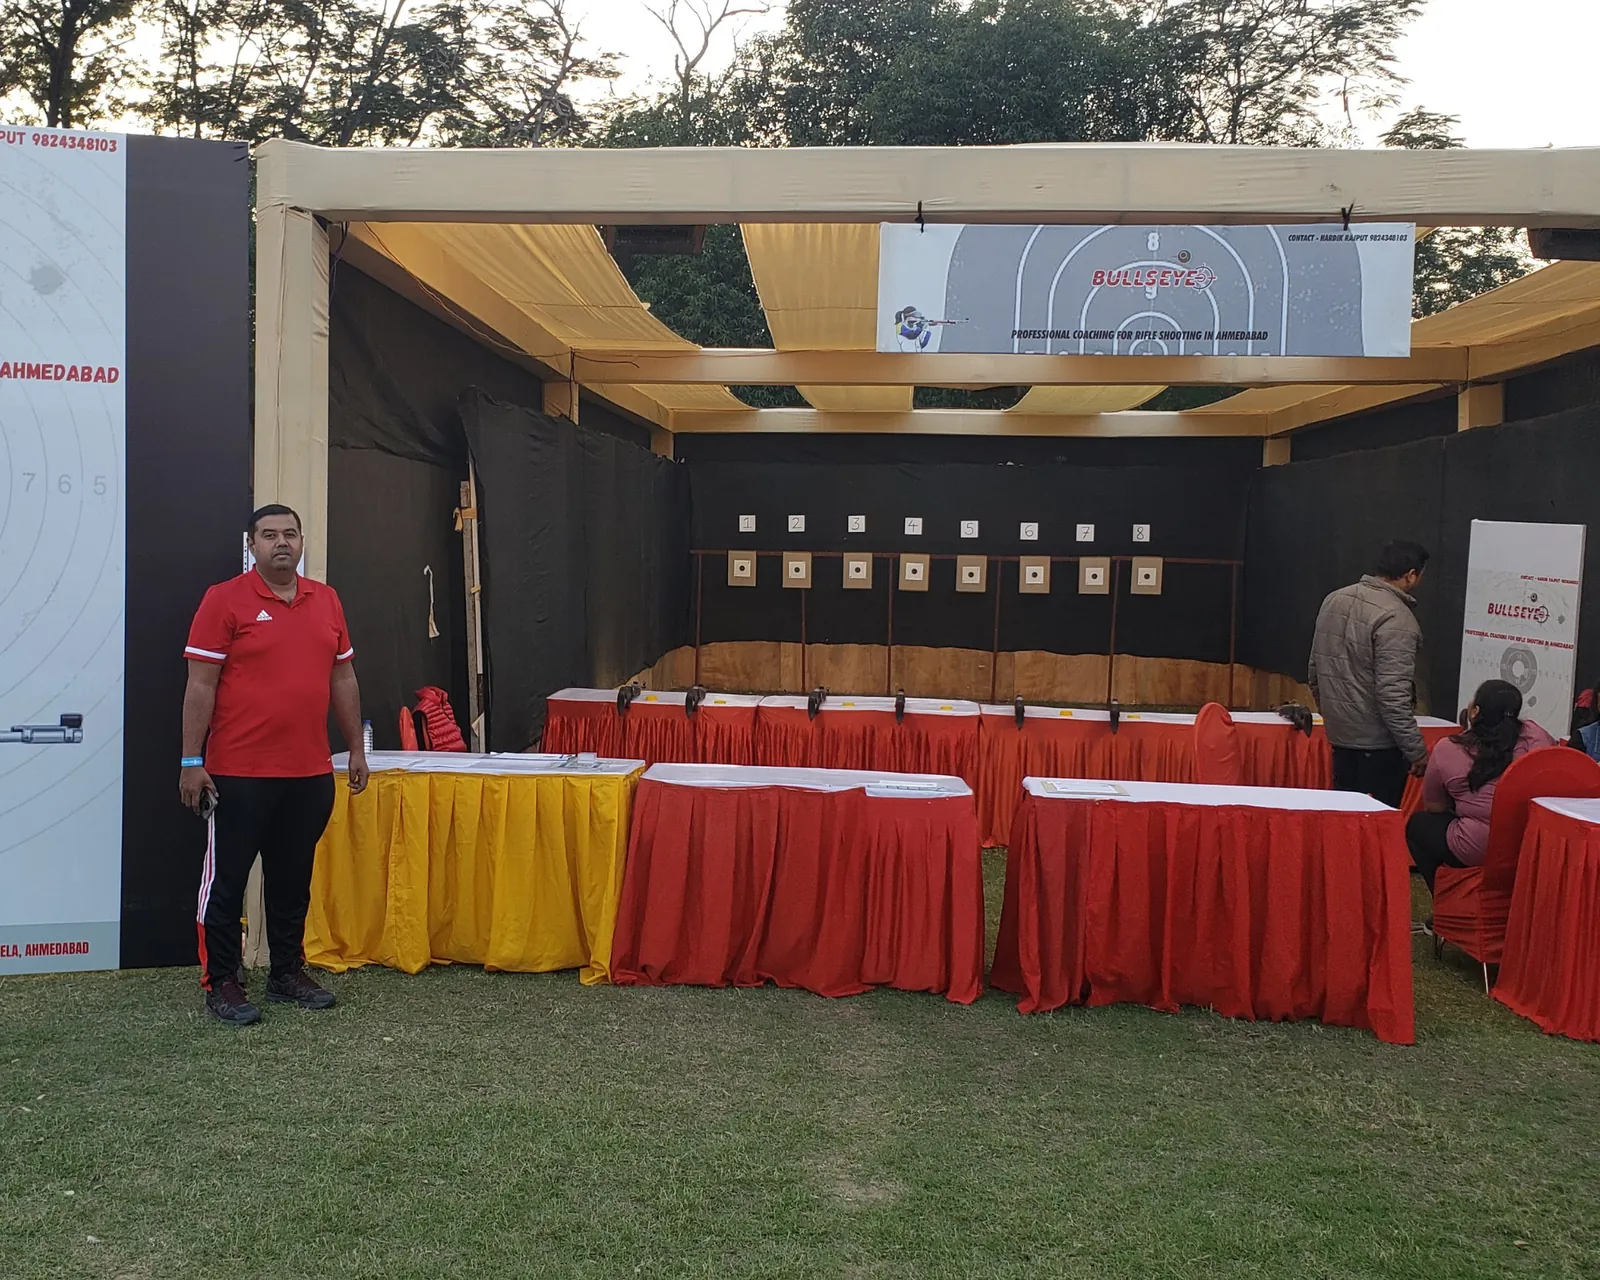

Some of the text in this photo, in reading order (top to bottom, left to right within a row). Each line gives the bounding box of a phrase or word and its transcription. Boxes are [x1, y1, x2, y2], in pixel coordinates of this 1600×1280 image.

[32, 133, 117, 152] 9824348103
[1147, 232, 1159, 251] 8
[1092, 270, 1198, 286] BULLSEYE
[1011, 329, 1268, 340] PROFESSIONAL COACHING FOR RIFLE SHOOTING IN AHMEDABAD
[0, 361, 119, 383] AHMEDABAD
[22, 472, 107, 495] 7 6 5
[743, 517, 752, 529] 1
[792, 517, 802, 529] 2
[851, 517, 860, 530] 3
[908, 519, 918, 533] 4
[964, 523, 974, 535] 5
[1025, 525, 1034, 537] 6
[1082, 526, 1091, 539] 7
[1136, 526, 1144, 540] 8
[1487, 602, 1540, 620] BULLSEYE
[25, 942, 89, 956] AHMEDABAD
